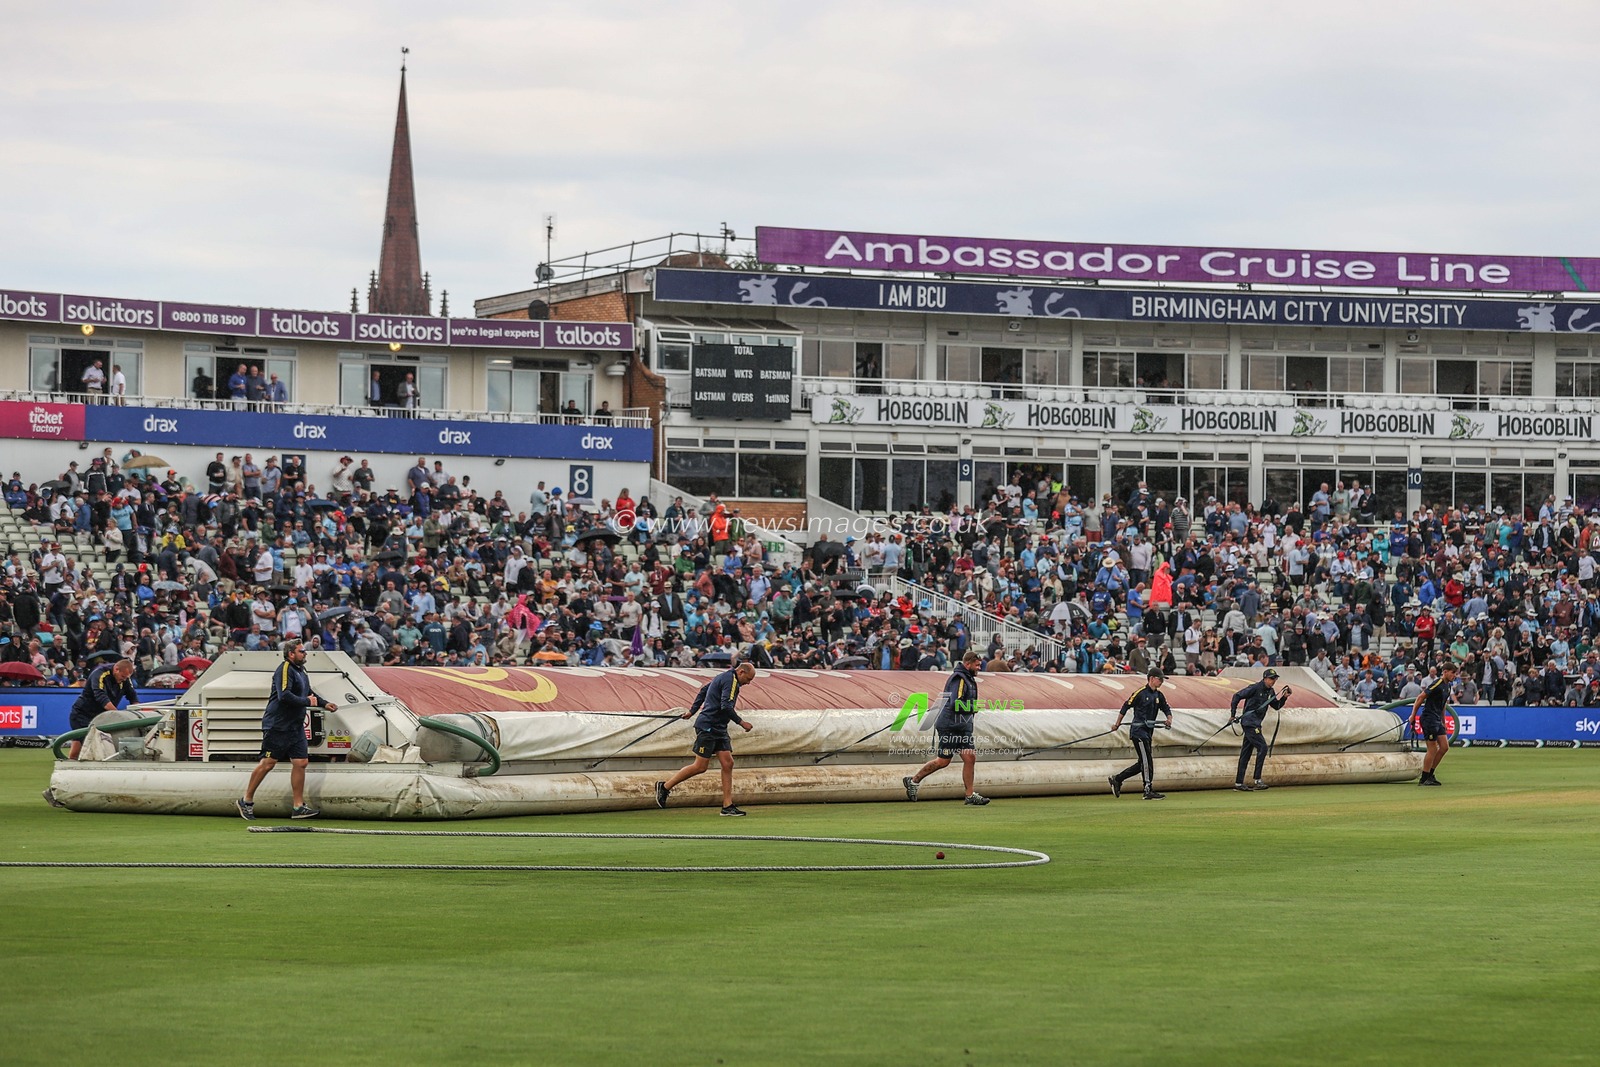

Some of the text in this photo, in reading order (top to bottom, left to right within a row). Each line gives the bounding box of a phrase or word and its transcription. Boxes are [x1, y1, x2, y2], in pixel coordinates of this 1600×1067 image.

[824, 235, 1511, 284] Ambassador Cruise Line
[879, 283, 947, 309] I AM BCU
[67, 300, 154, 325] solicitors
[171, 310, 246, 327] 0800 118 1500
[1131, 296, 1467, 326] BIRMINGHAM CITY UNIVERSITY
[271, 312, 340, 337] talbots
[359, 319, 443, 341] solicitors
[479, 326, 503, 339] legal
[504, 328, 540, 341] experts
[555, 325, 621, 346] talbots
[733, 346, 754, 355] TOTAL
[695, 367, 791, 380] BATSMAN WKTS BATSMAN
[694, 391, 726, 401] LASTMAN
[732, 392, 754, 403] OVERS
[29, 410, 64, 424] ticket
[878, 398, 969, 425] HOBGOBLIN
[1027, 403, 1117, 429] HOBGOBLIN
[1181, 408, 1277, 433] HOBGOBLIN
[32, 423, 62, 435] factory
[143, 414, 178, 433] drax
[293, 421, 327, 440] drax
[1340, 411, 1435, 435] HOBGOBLIN
[1497, 414, 1593, 438] HOBGOBLIN
[438, 427, 471, 445] drax
[581, 433, 613, 450] drax
[962, 463, 970, 476] 9
[1408, 472, 1422, 486] 10
[573, 468, 589, 495] 8
